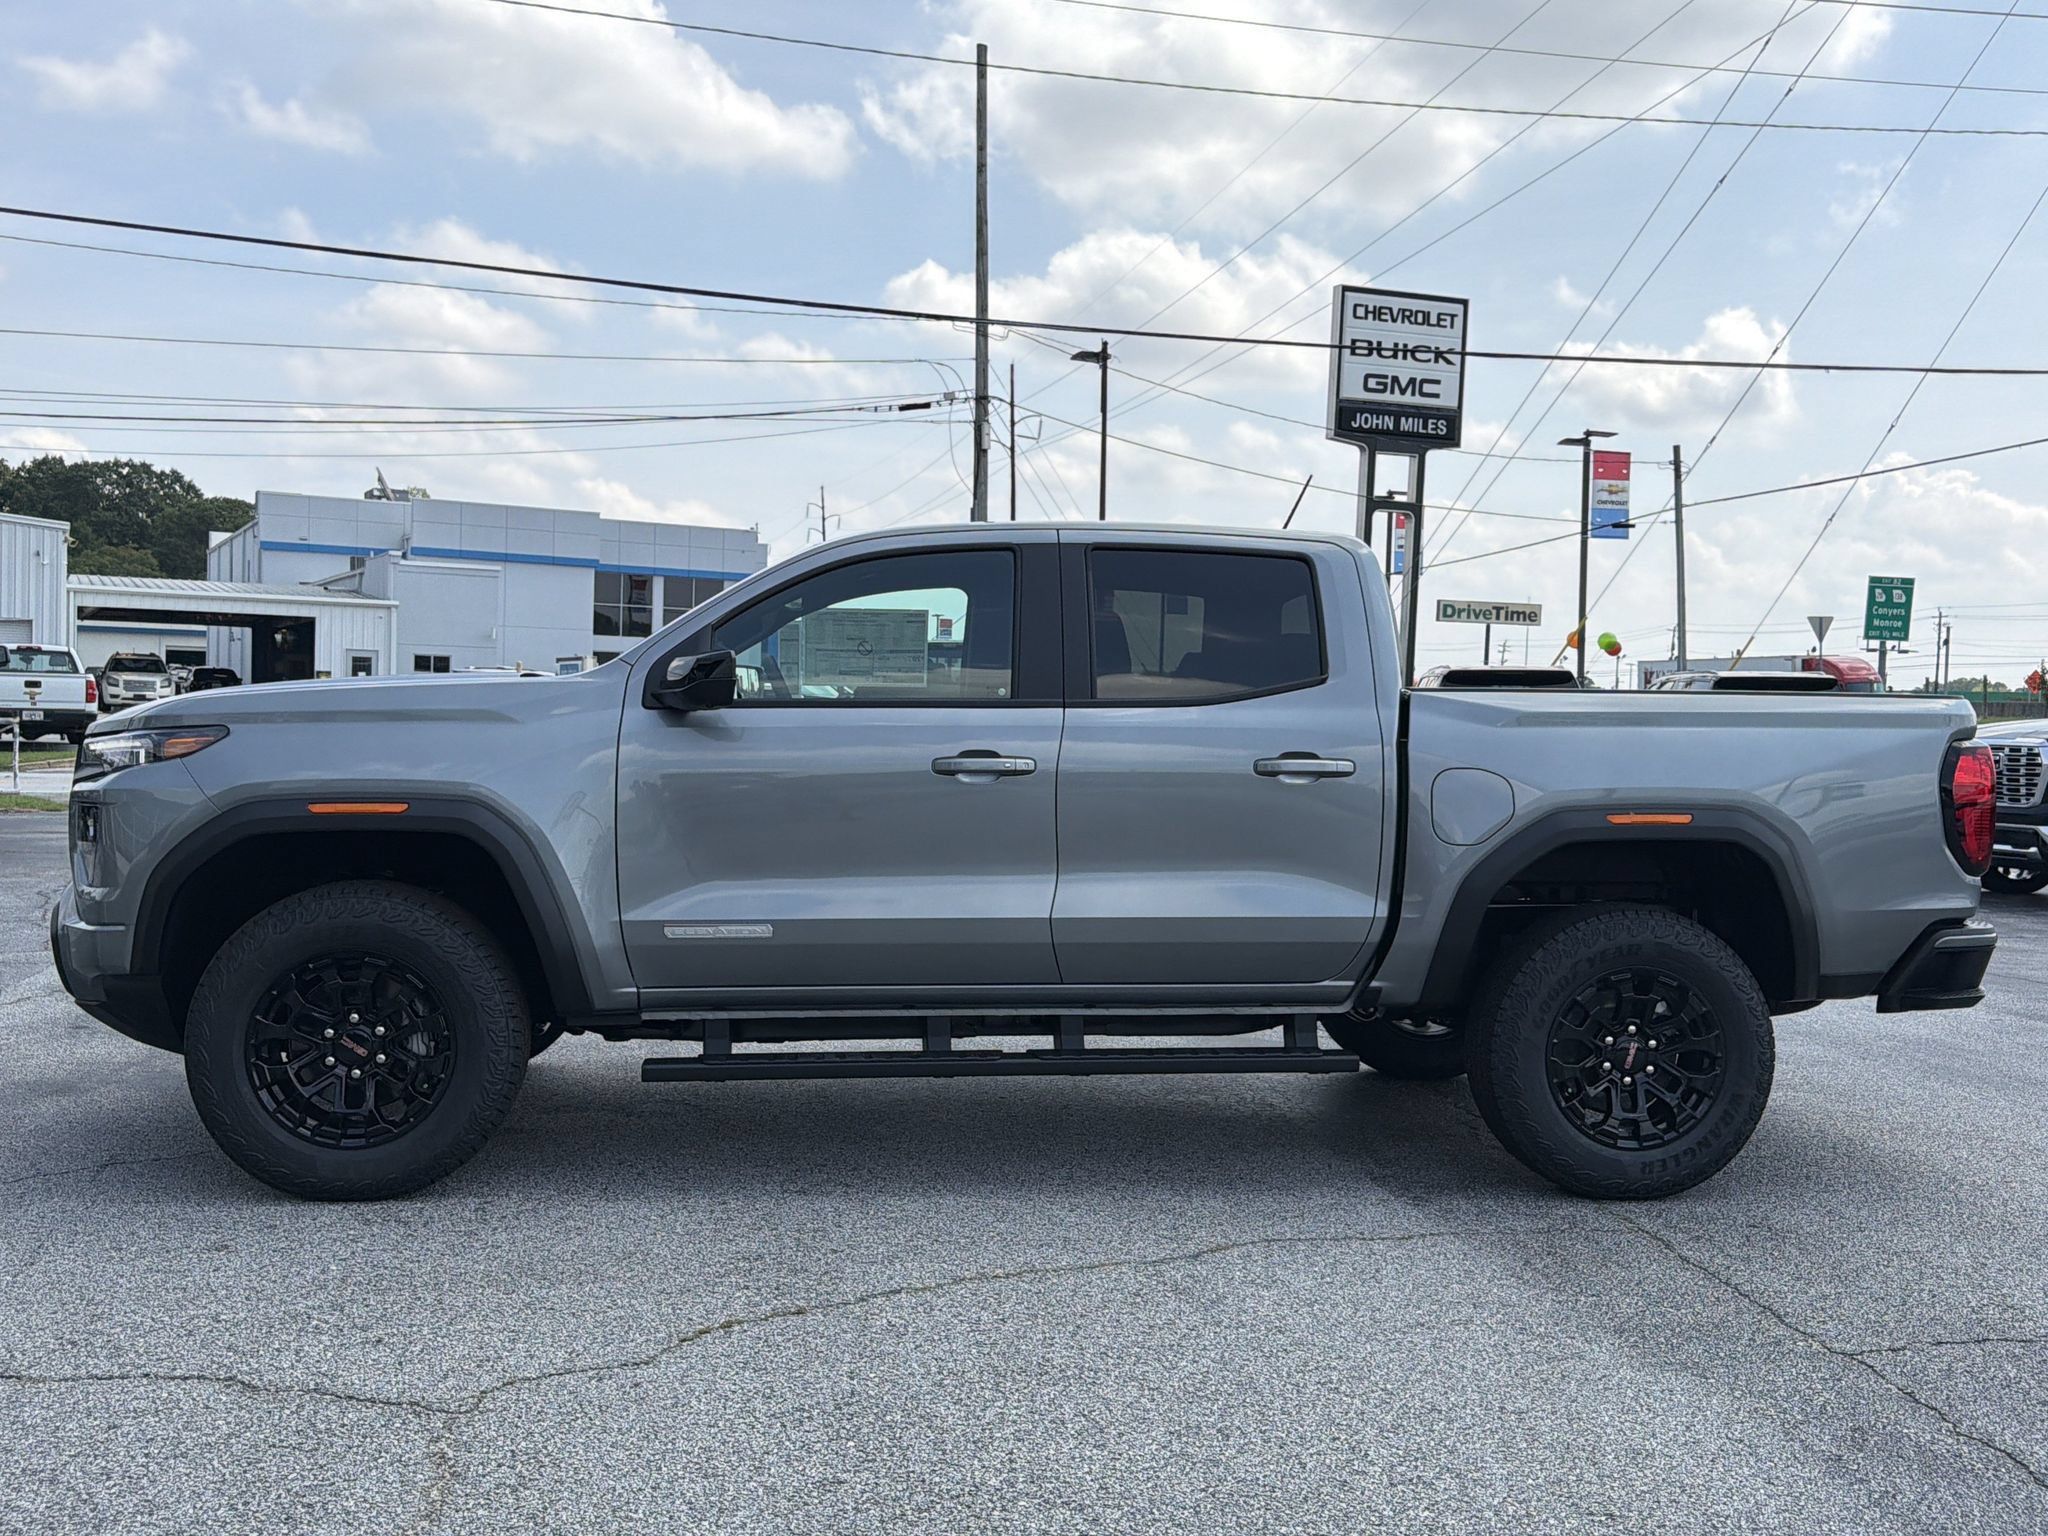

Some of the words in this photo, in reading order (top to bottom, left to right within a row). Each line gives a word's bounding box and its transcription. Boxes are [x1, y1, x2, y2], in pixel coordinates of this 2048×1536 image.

[1352, 303, 1459, 330] CHEVROLET
[1349, 338, 1457, 366] BUICK
[1362, 373, 1442, 399] GMC
[1351, 412, 1394, 431] JOHN
[1400, 417, 1448, 436] MILES
[1442, 603, 1538, 623] DriveTime
[1872, 605, 1905, 616] Conyers
[1873, 618, 1903, 628] Monroe
